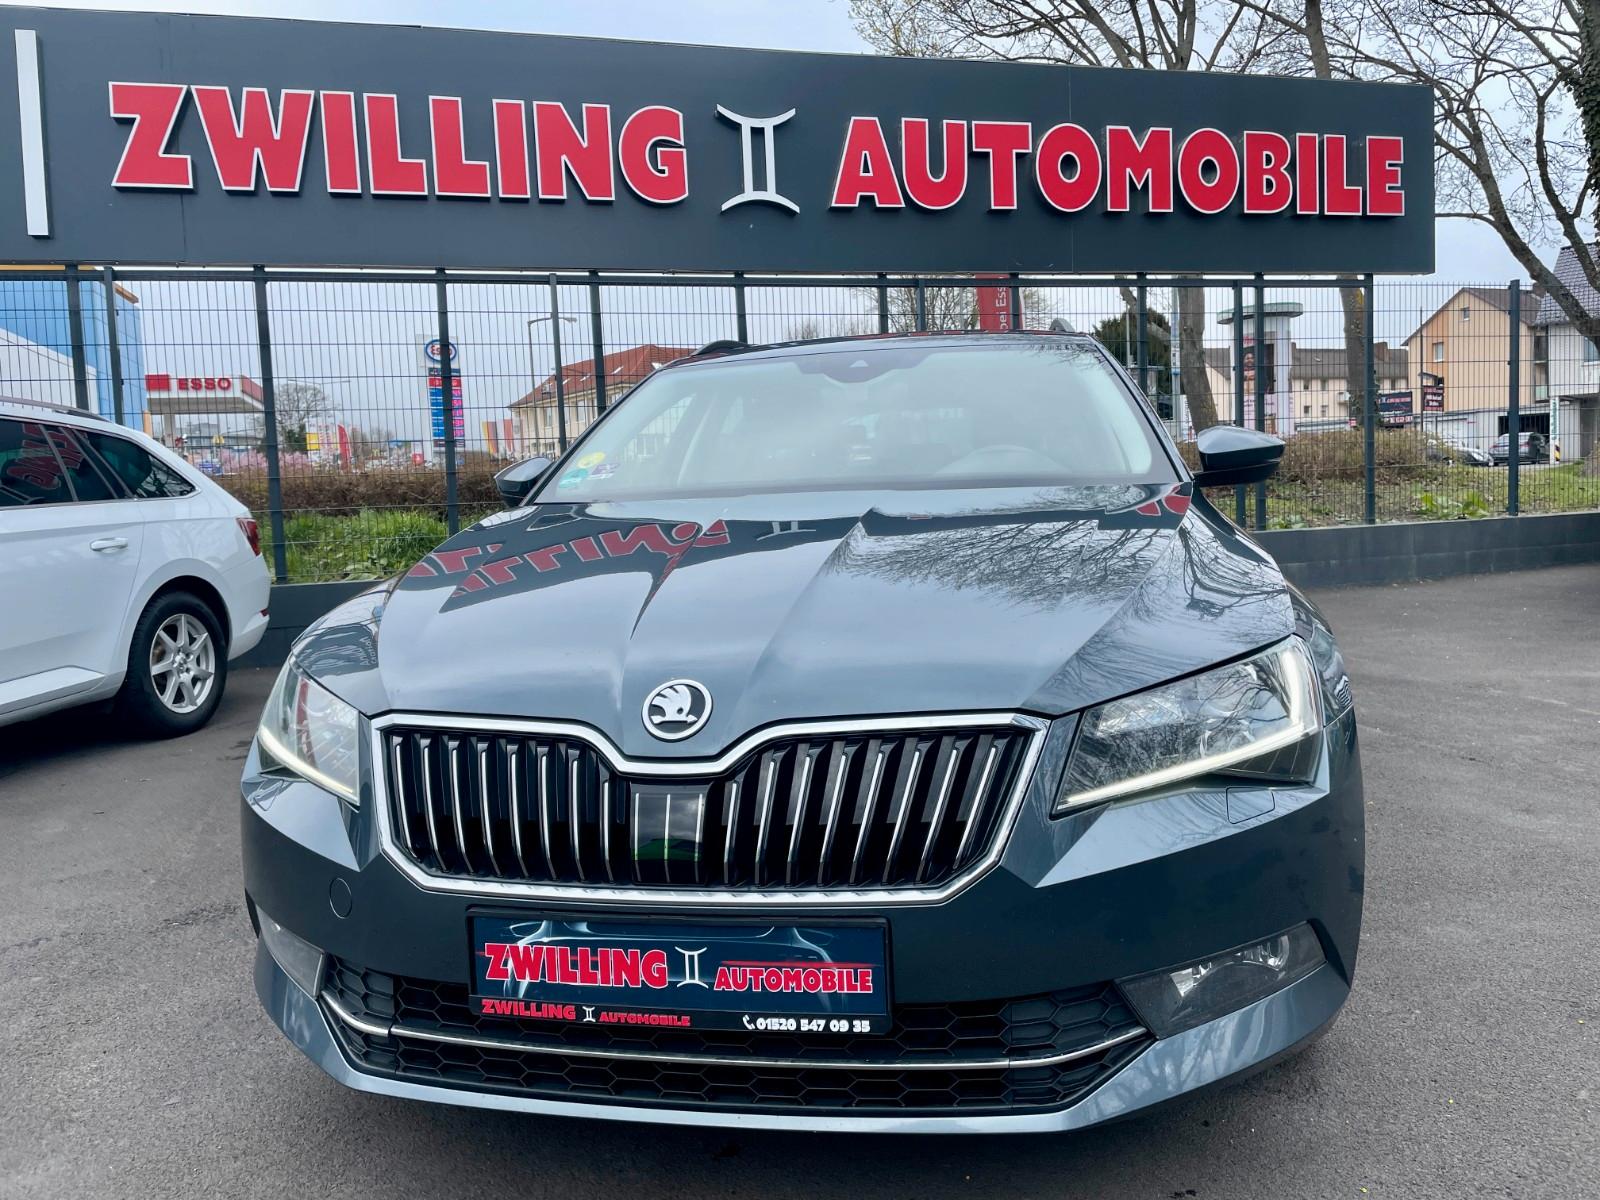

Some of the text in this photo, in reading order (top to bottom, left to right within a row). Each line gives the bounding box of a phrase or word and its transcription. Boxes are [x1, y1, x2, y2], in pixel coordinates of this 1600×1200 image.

[109, 81, 1406, 217] ZWILLING AUTOMOBILE
[177, 377, 232, 390] ESSO
[485, 943, 873, 994] ZWILLING AUTOMOBILE
[482, 999, 691, 1027] ZWILLING AUTOMOBILE
[756, 1017, 871, 1033] 01520 547 09 35
